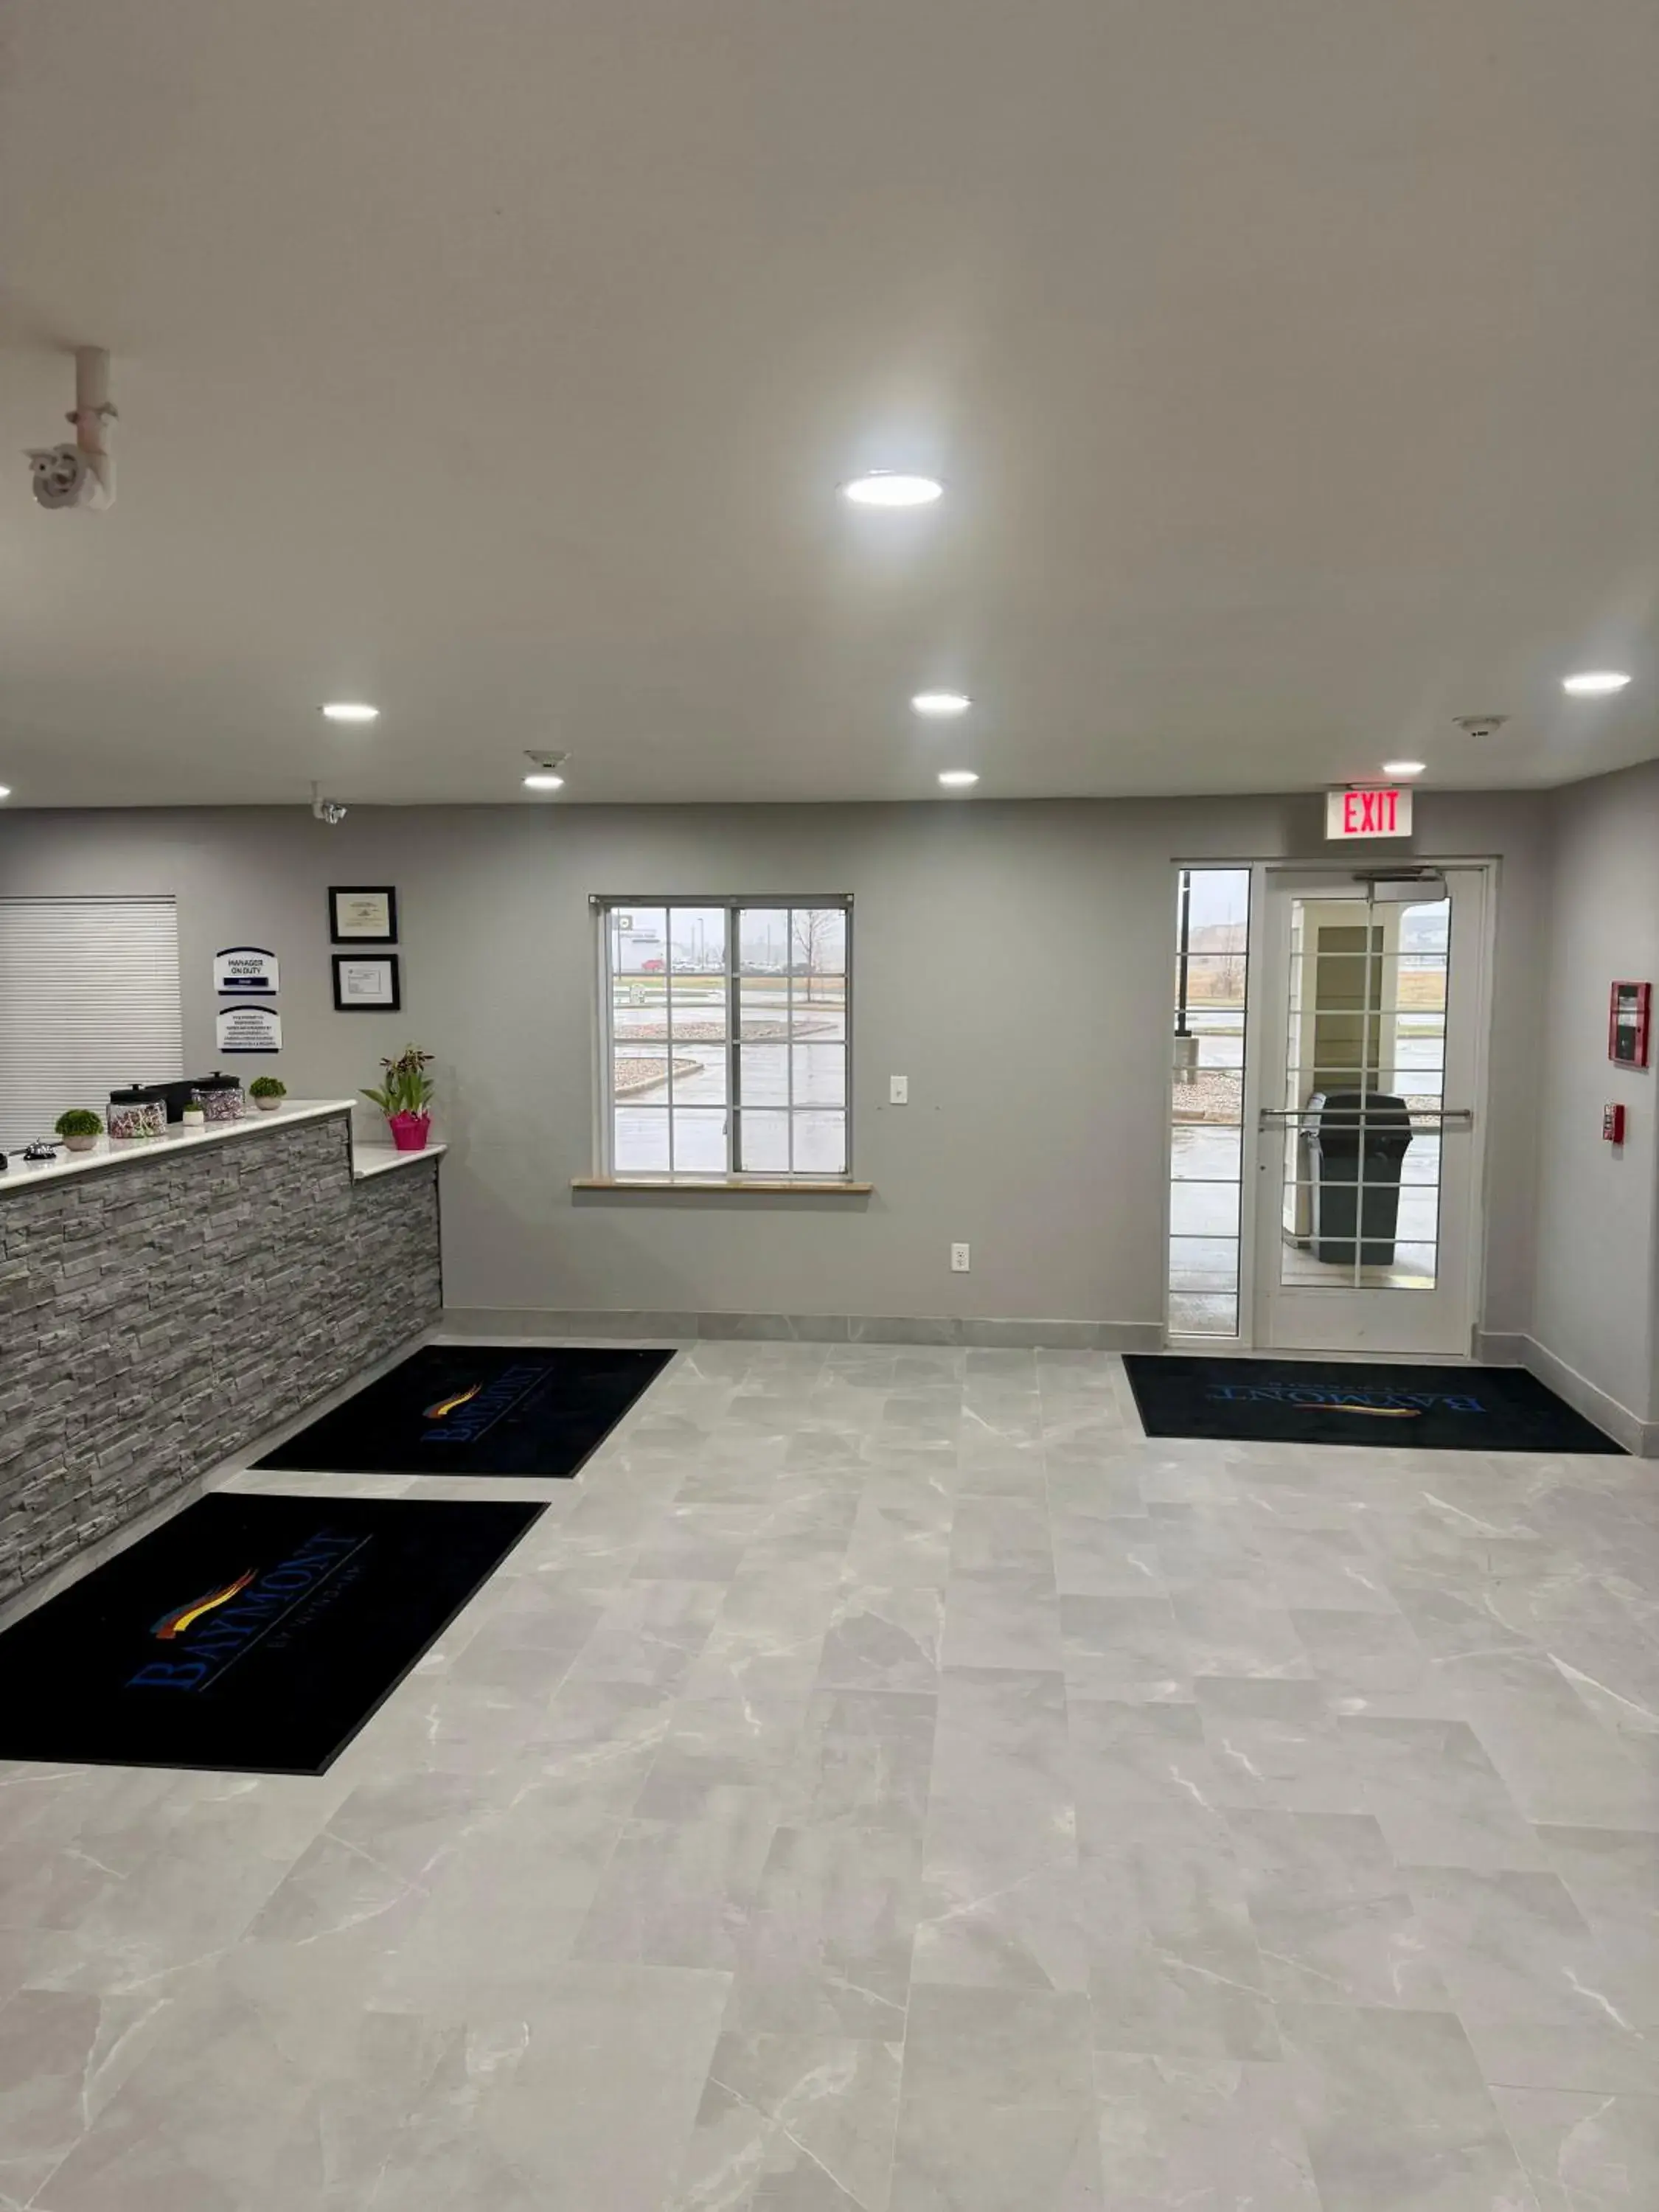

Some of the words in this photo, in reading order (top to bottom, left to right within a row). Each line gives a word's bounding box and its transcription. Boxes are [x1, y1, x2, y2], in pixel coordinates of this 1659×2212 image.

[1344, 791, 1399, 832] EXIT
[420, 1363, 543, 1443] BAYMONT
[1206, 1387, 1487, 1412] BAYMONT
[124, 1524, 358, 1690] BAYMONT
